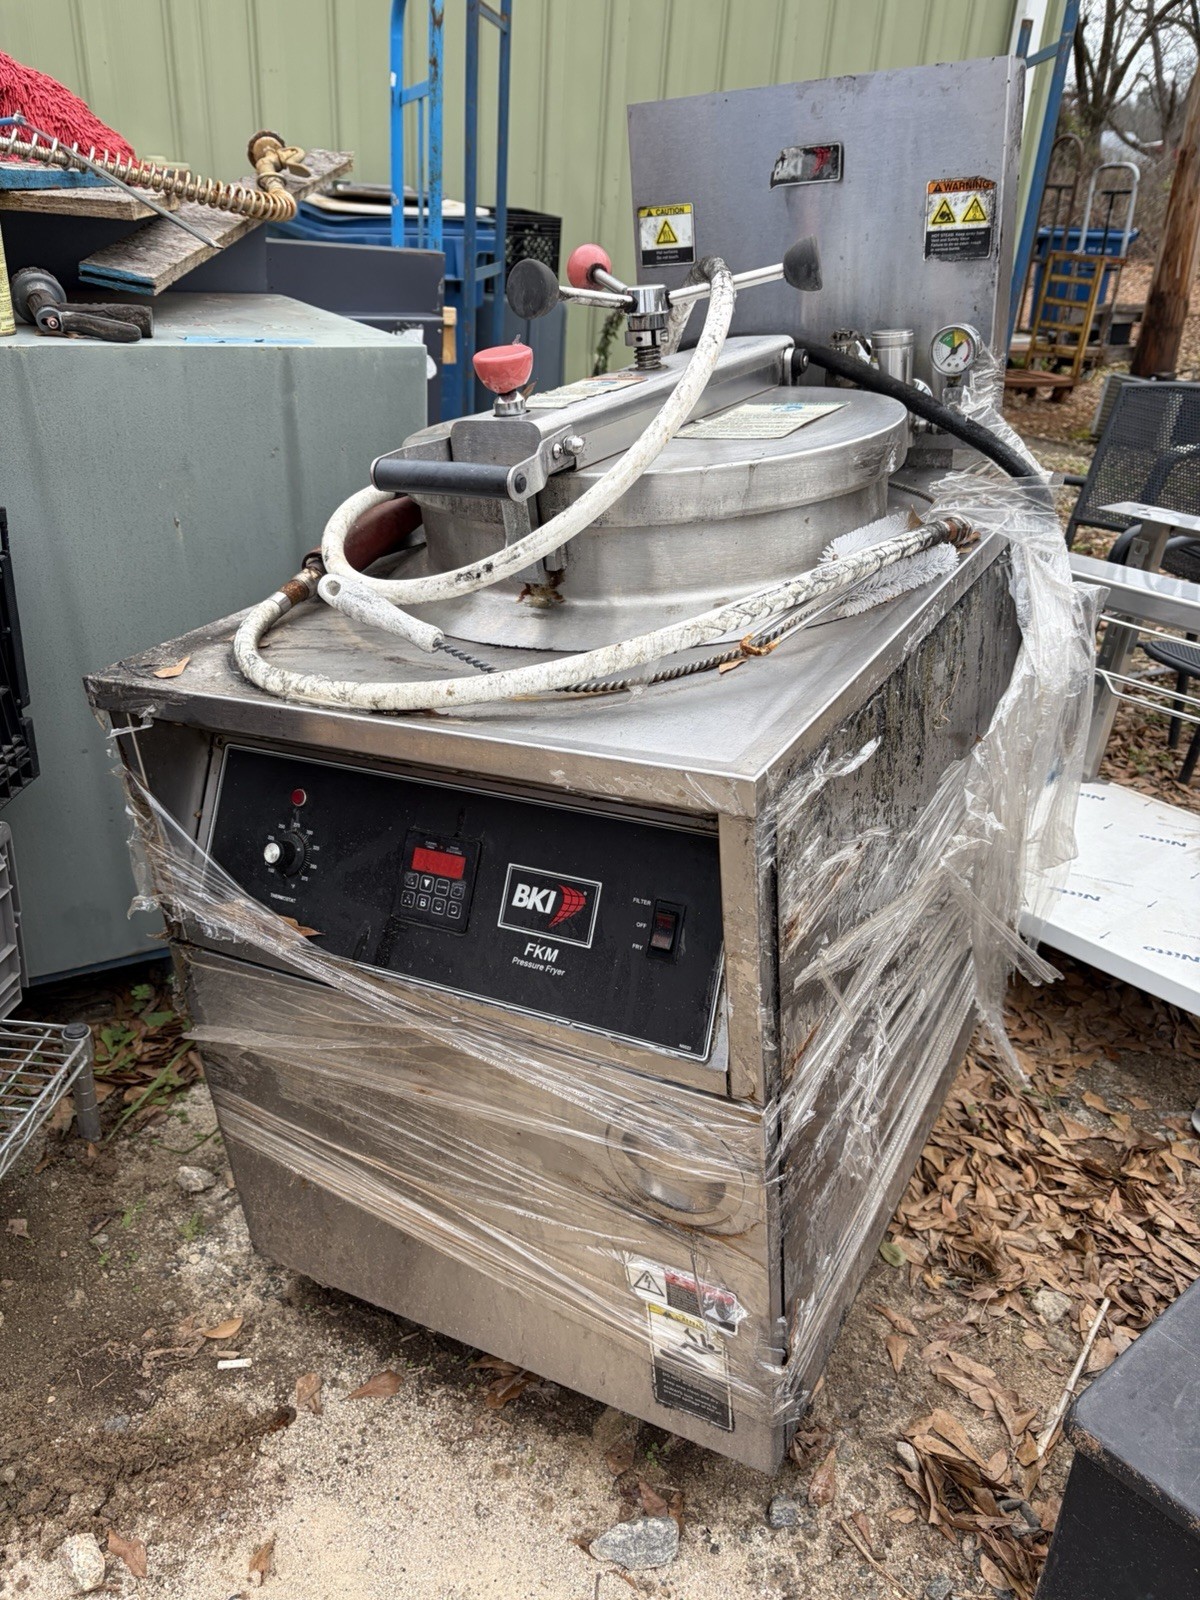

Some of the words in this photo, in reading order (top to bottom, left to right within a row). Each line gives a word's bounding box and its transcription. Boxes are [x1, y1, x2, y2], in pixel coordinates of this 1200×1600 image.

[944, 181, 990, 191] WARNING
[656, 207, 684, 216] CAUTION
[1139, 834, 1187, 848] Nitto
[270, 892, 296, 903] THERMOSTAT
[511, 883, 557, 914] BKI
[1049, 886, 1101, 902] Nitto
[632, 897, 651, 906] FILTER
[636, 921, 647, 929] OFF
[523, 942, 559, 963] FKM
[632, 943, 643, 951] FRY
[1142, 945, 1200, 964] Nitto
[512, 956, 545, 972] Pressure
[545, 963, 566, 977] Fryer
